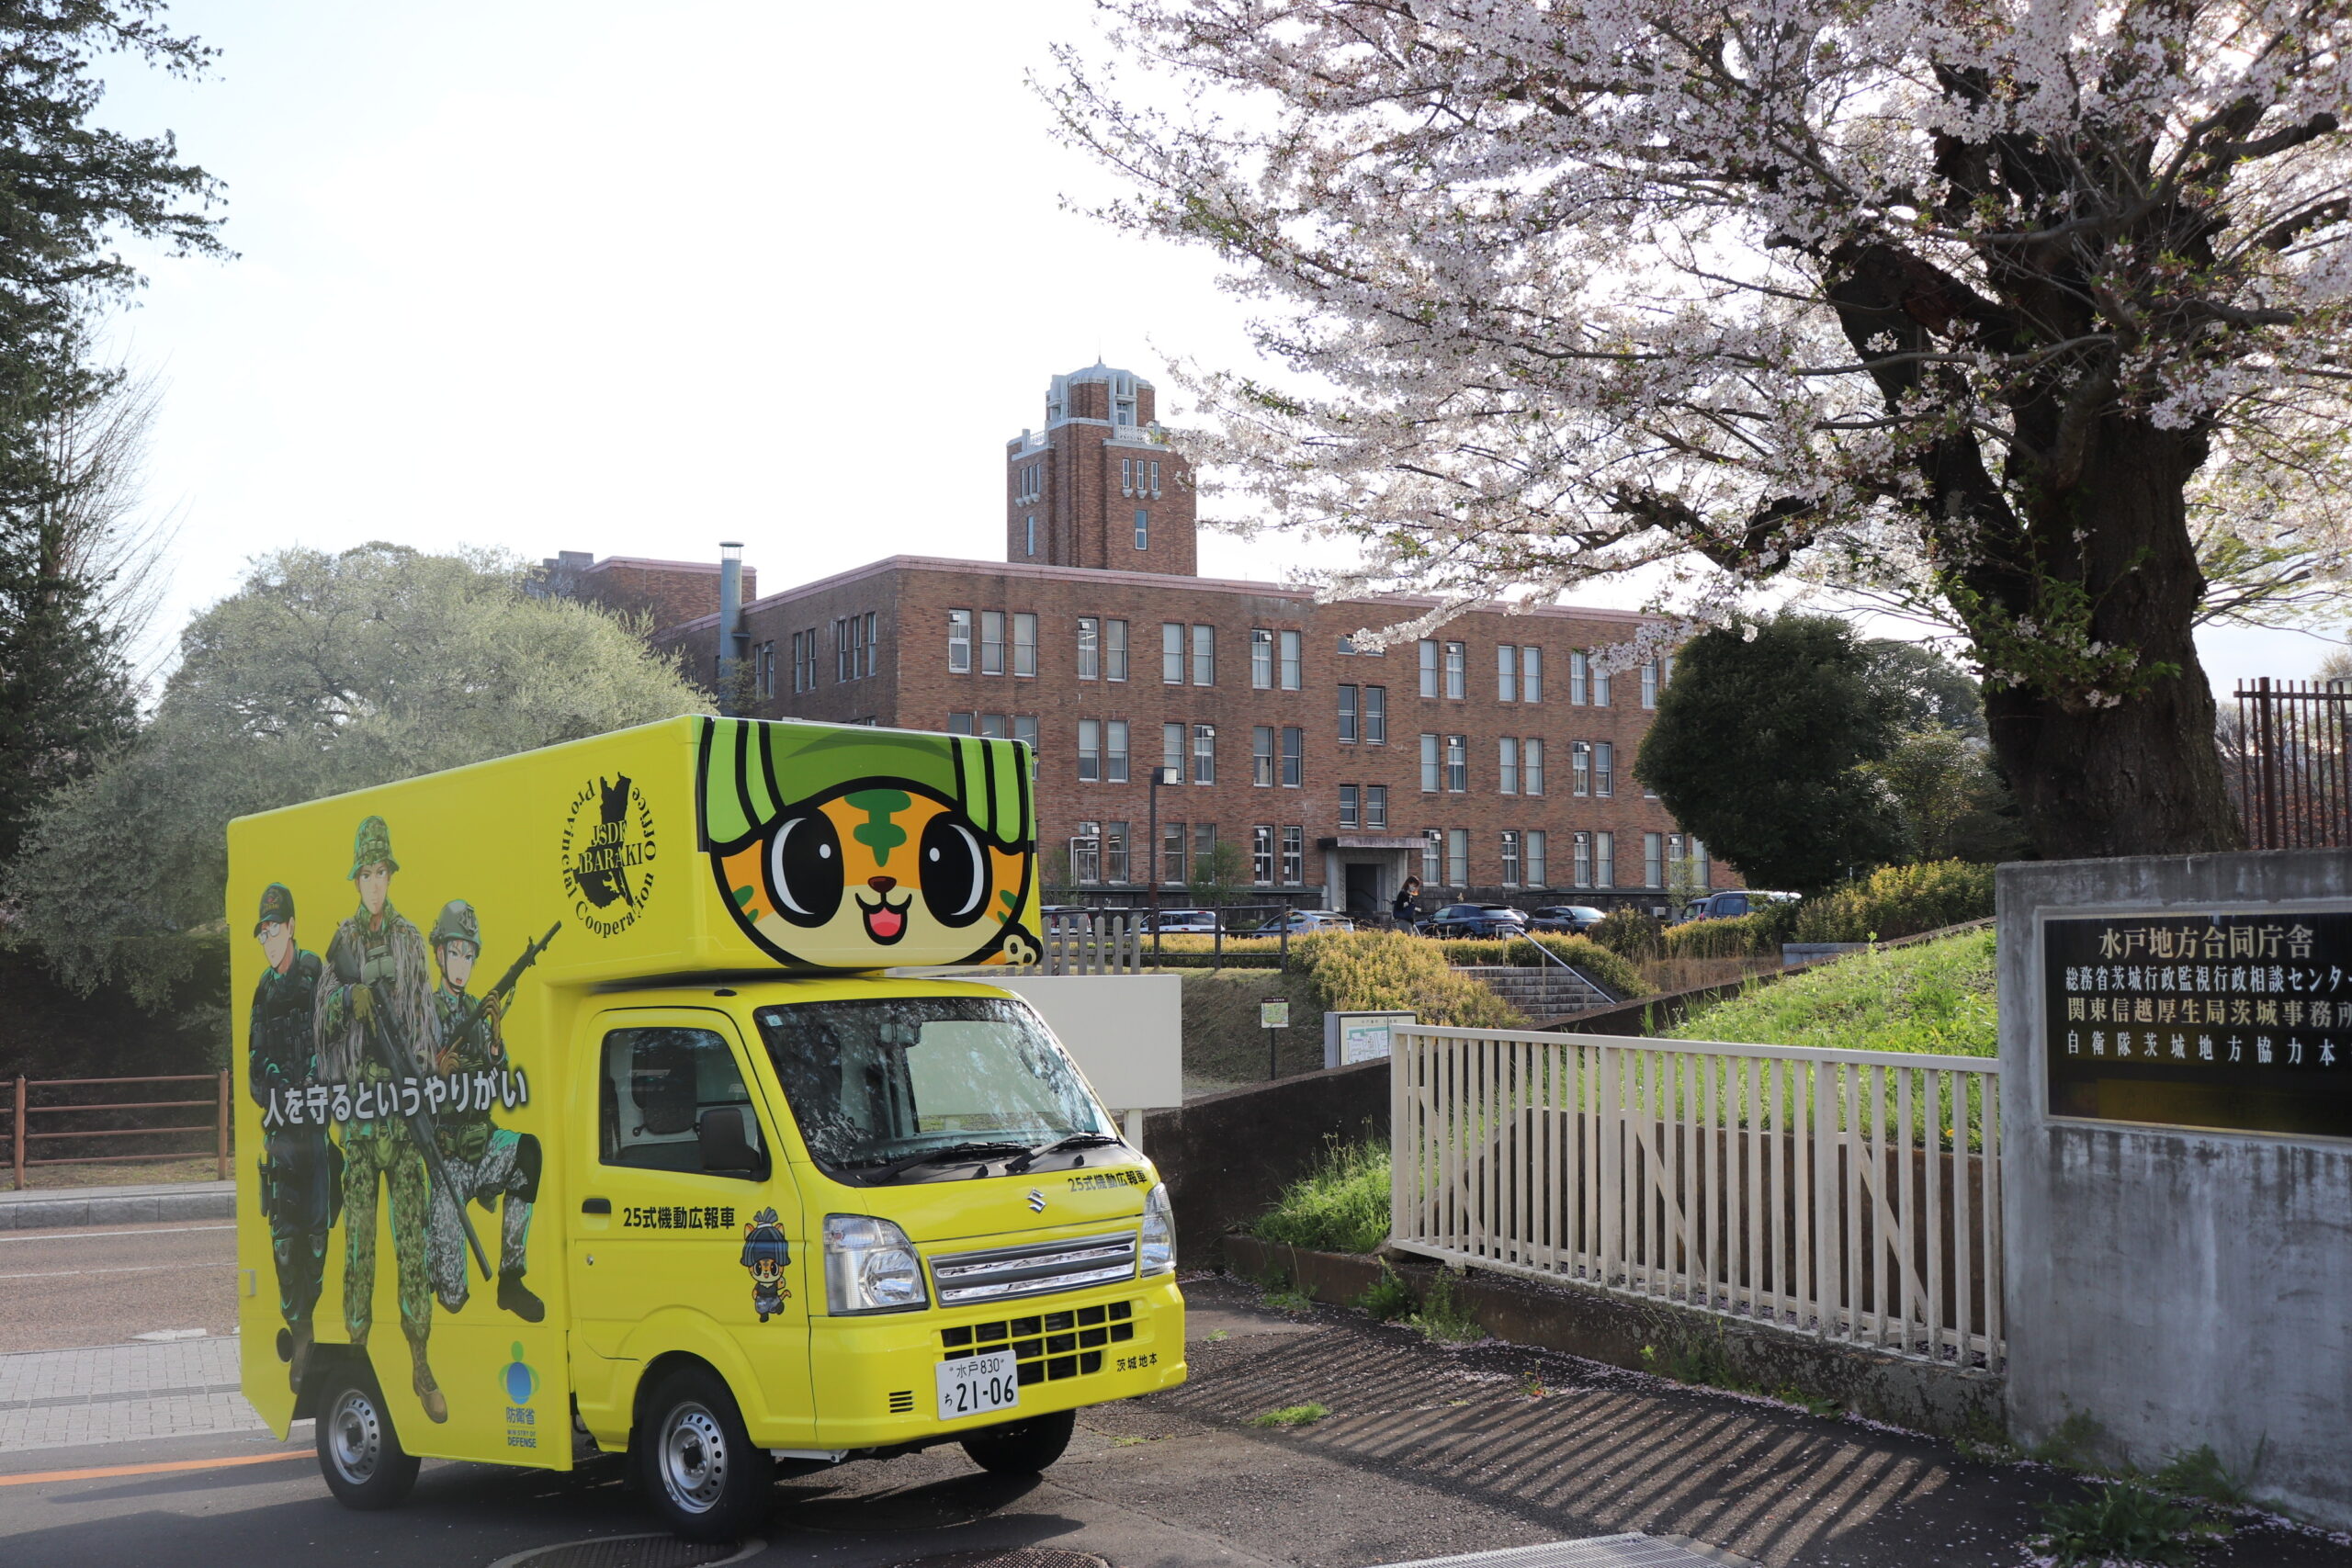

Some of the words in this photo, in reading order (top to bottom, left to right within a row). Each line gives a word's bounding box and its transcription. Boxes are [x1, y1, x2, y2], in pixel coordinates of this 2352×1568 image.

[561, 779, 596, 898] Provincial
[591, 819, 627, 847] JSDF
[632, 787, 656, 861] Office
[578, 843, 643, 874] IBARAKI
[576, 873, 655, 938] Cooperation
[2098, 923, 2314, 960] 水戸地方合同庁舎
[2065, 964, 2352, 993] 総務省茨城行政監視行政相談センタ
[2067, 1030, 2352, 1066] 自衛隊茨城地方協力本
[263, 1069, 527, 1128] 人を守るというやりがい
[1068, 1170, 1148, 1192] 25式機動広報車
[623, 1206, 736, 1230] 25式機動広報車
[1116, 1352, 1158, 1372] 茨城地本
[956, 1374, 1014, 1413] 21-06
[506, 1406, 535, 1425] 防衛省
[508, 1436, 537, 1449] DEFENSE
